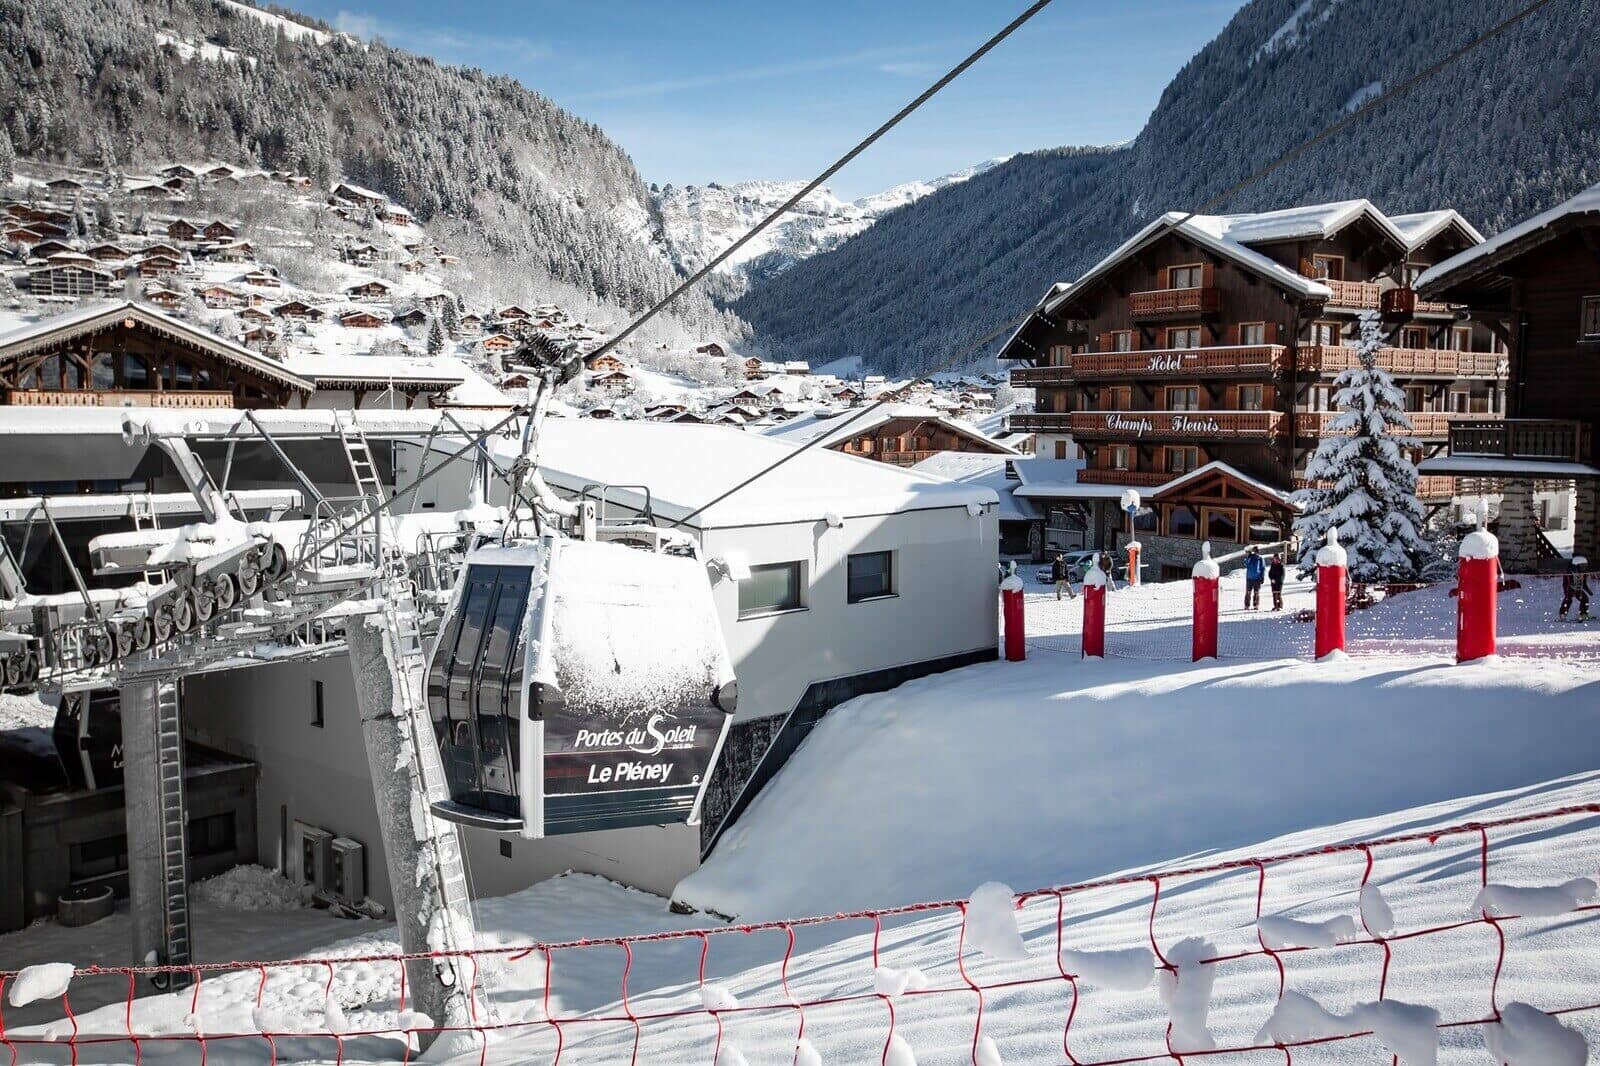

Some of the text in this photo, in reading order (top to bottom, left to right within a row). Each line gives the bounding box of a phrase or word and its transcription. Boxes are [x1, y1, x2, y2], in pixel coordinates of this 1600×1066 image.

[1148, 354, 1181, 370] Hotel
[1105, 414, 1219, 437] Champs Fleuris
[574, 728, 624, 747] Portes
[625, 727, 647, 745] du
[646, 714, 697, 756] Soleil
[587, 761, 674, 784] Le Pléney
